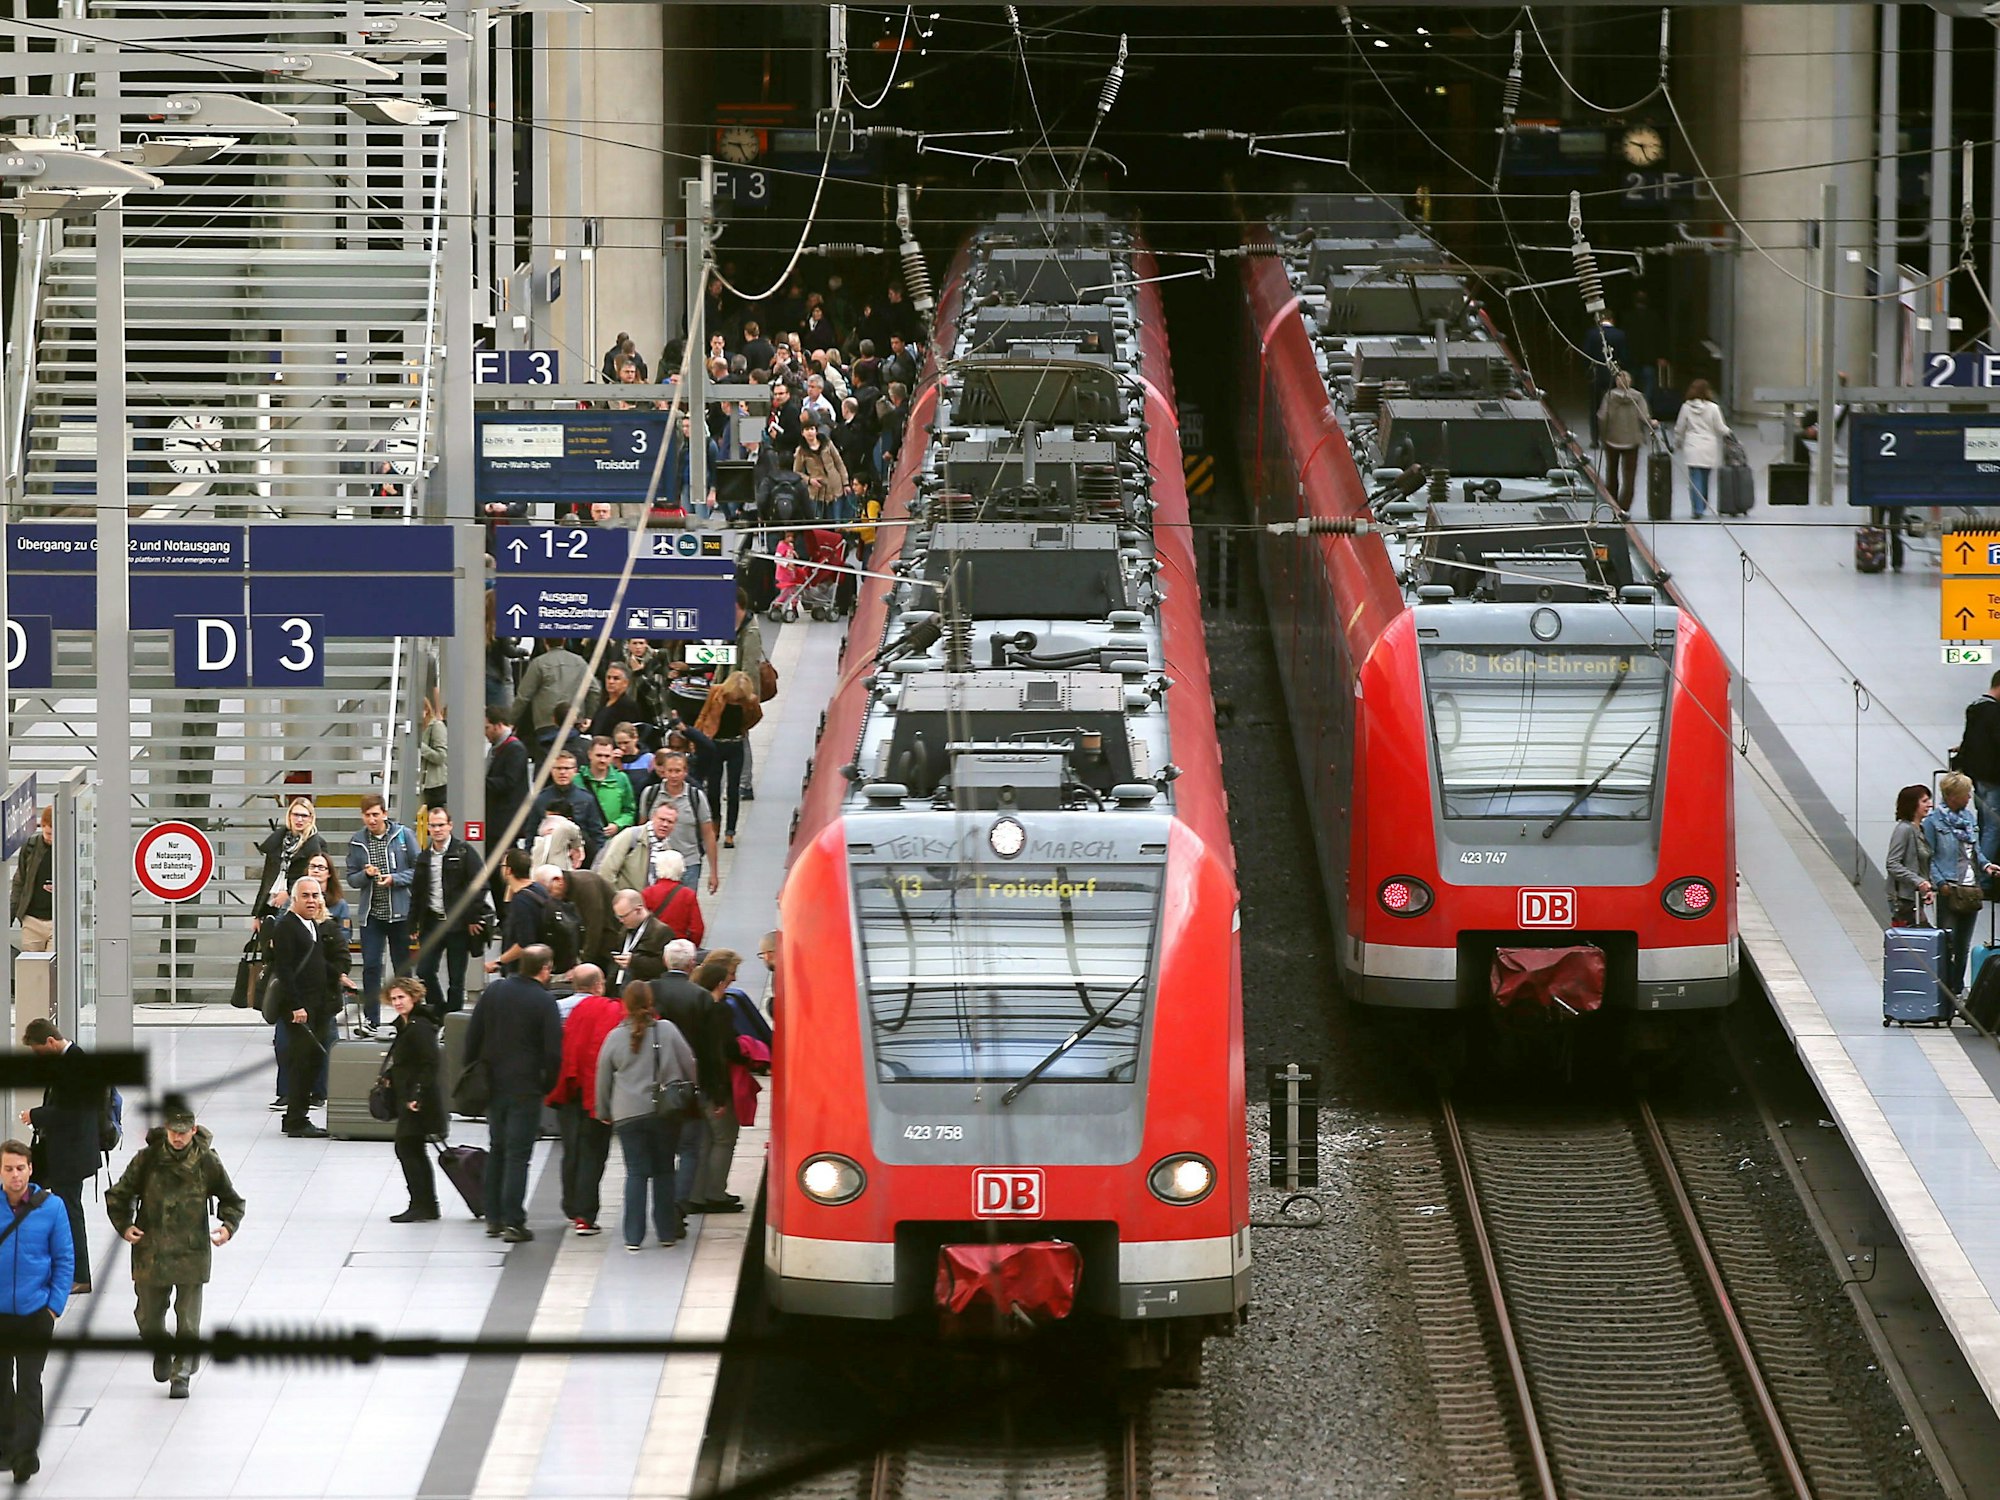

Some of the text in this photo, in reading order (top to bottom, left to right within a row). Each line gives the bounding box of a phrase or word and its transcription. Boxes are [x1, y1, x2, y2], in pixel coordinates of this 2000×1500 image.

[749, 172, 766, 198] 3
[1626, 172, 1644, 199] 2
[528, 352, 552, 384] 3
[1930, 354, 1956, 387] 2
[631, 429, 648, 454] 3
[1880, 432, 1897, 456] 2
[595, 459, 640, 470] Troisdorf
[17, 536, 72, 553] Übergang
[74, 540, 88, 551] zu
[127, 540, 138, 551] -2
[140, 540, 162, 552] und
[164, 540, 230, 554] Notausgang
[540, 529, 588, 559] 1-2
[680, 541, 696, 550] Bus
[135, 556, 161, 564] platform
[184, 557, 217, 565] emergency
[539, 590, 588, 605] Ausgang
[1988, 593, 2000, 604] Te
[1988, 608, 2000, 619] Te
[197, 617, 315, 671] D 3
[168, 841, 179, 849] Nur
[156, 852, 191, 861] Notausgang
[1460, 852, 1508, 864] 423 747
[163, 862, 197, 871] Bahnsteig-
[161, 872, 186, 880] wechsel
[970, 874, 1097, 898] Troisdorf
[1526, 895, 1569, 921] DB
[904, 1125, 964, 1140] 423 758
[983, 1177, 1035, 1210] DB
